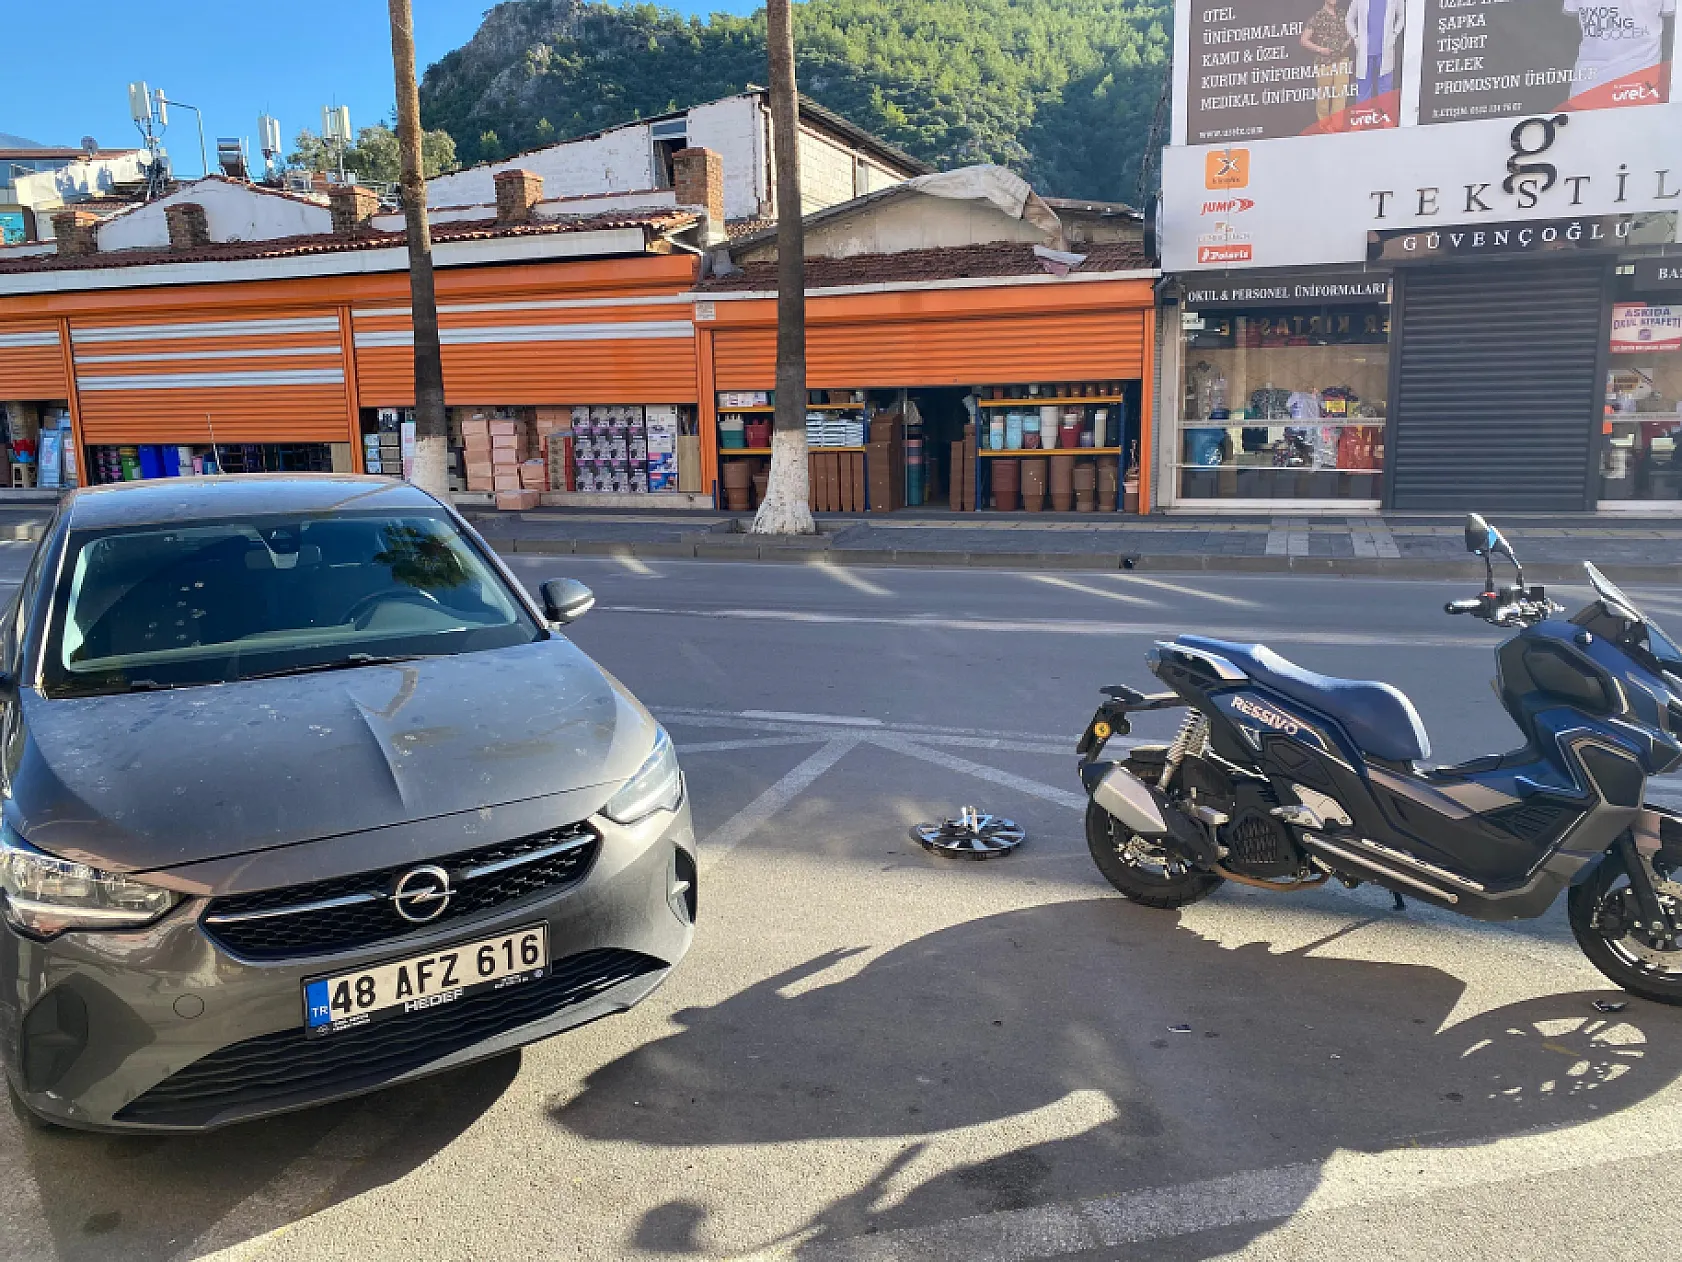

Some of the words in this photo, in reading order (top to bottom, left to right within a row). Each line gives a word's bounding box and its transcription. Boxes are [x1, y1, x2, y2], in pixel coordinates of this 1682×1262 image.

[1203, 7, 1236, 23] OTEL
[1438, 13, 1487, 34] ŞAPKA
[1203, 21, 1304, 45] ÜNİFORMALARI
[1436, 33, 1488, 54] TİŞÖRT
[1201, 51, 1240, 67] KAMU
[1243, 51, 1253, 63] &
[1256, 46, 1289, 61] ÖZEL
[1436, 56, 1484, 75] YELEK
[1201, 72, 1248, 89] KURUM
[1252, 61, 1354, 84] ÜNİFORMALARI
[1434, 74, 1521, 95] PROMOSYON
[1200, 93, 1259, 111] MEDİKAL
[1369, 164, 1681, 219] TEKSTİL
[1200, 200, 1236, 216] JUMP
[1403, 220, 1634, 252] GÜVENÇOĞLU
[1658, 267, 1682, 280] BA
[1188, 290, 1219, 303] OKUL
[1220, 289, 1228, 301] &
[1232, 286, 1290, 300] PERSONEL
[1295, 282, 1386, 298] ÜNİFORMALARI
[333, 975, 377, 1013] 48
[396, 953, 459, 999] AFZ
[477, 934, 539, 977] 616
[310, 1005, 328, 1018] TR
